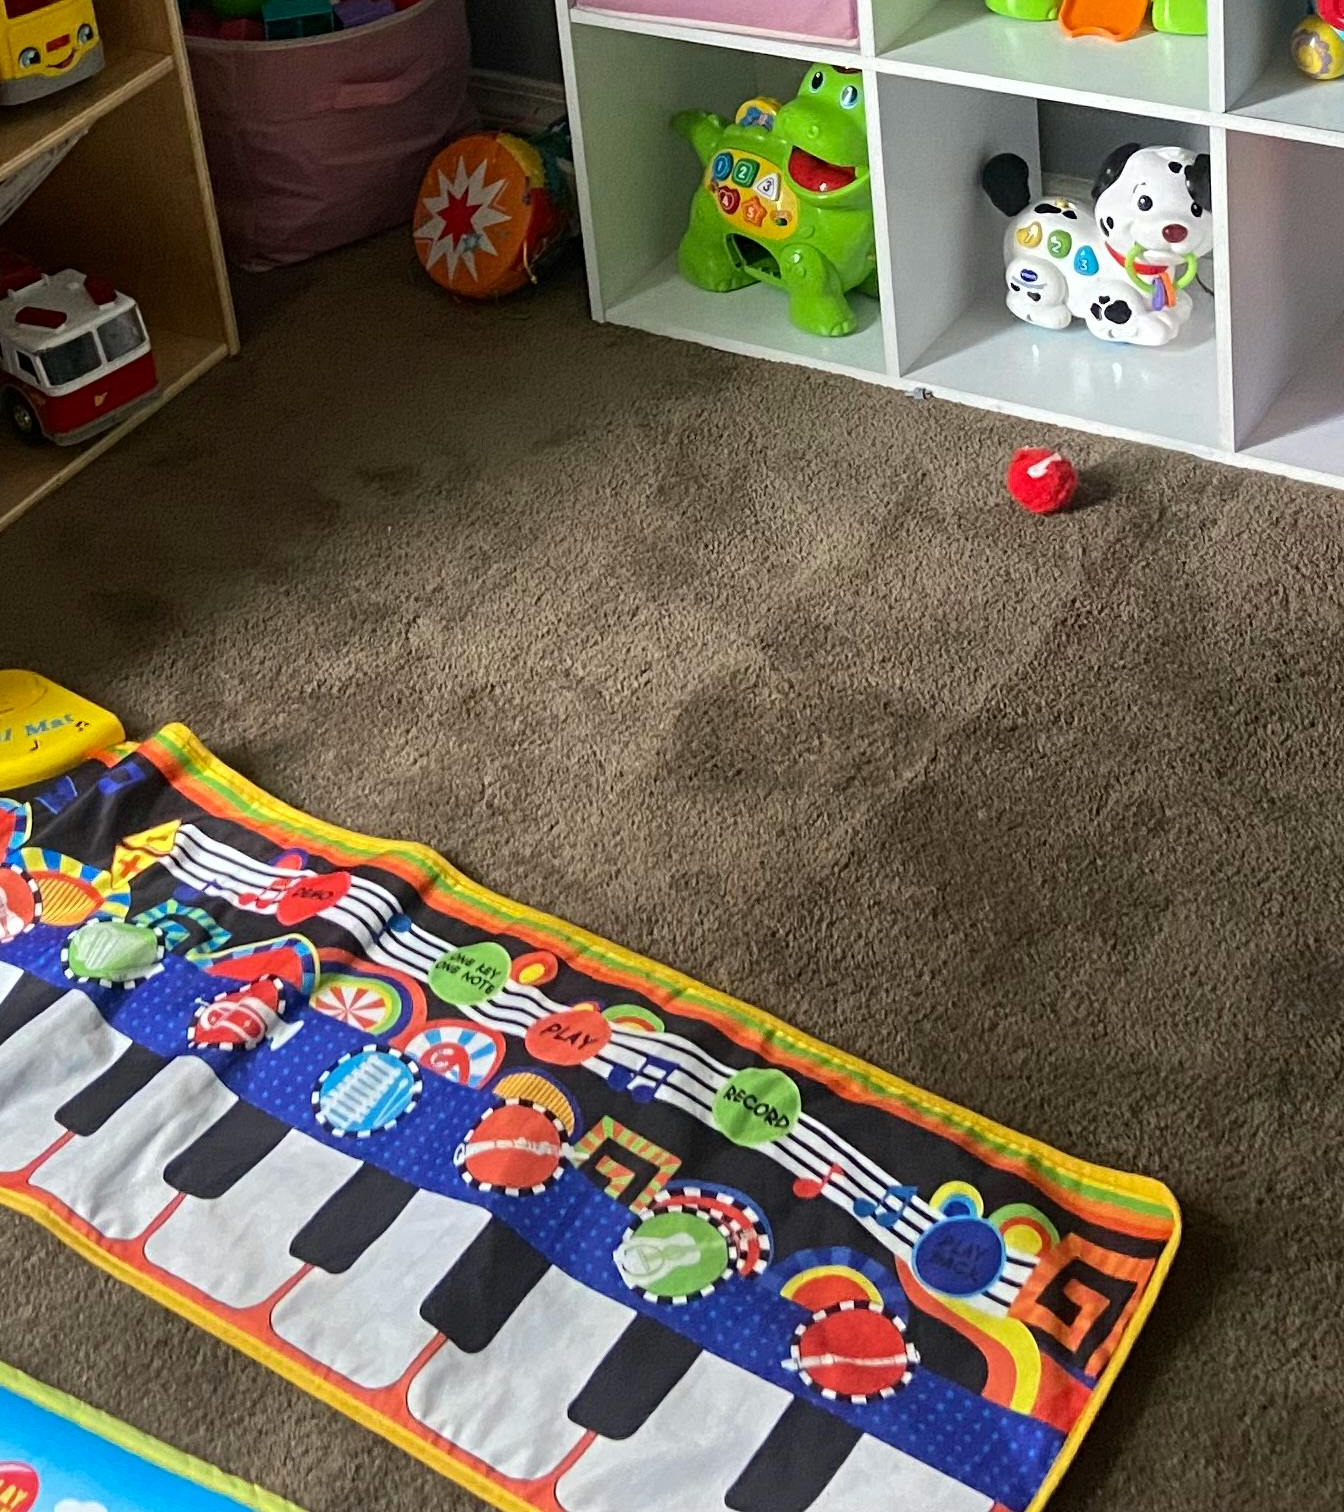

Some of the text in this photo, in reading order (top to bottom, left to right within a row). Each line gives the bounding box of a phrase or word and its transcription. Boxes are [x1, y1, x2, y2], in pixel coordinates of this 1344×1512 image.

[738, 165, 748, 179] 2
[762, 180, 773, 192] 3
[1051, 240, 1062, 254] 2
[1079, 259, 1089, 271] 3
[25, 713, 74, 737] Mat
[434, 960, 494, 994] ONE NOTE
[479, 963, 502, 980] KEY
[542, 1023, 594, 1051] PLAY
[723, 1085, 790, 1130] RECORD
